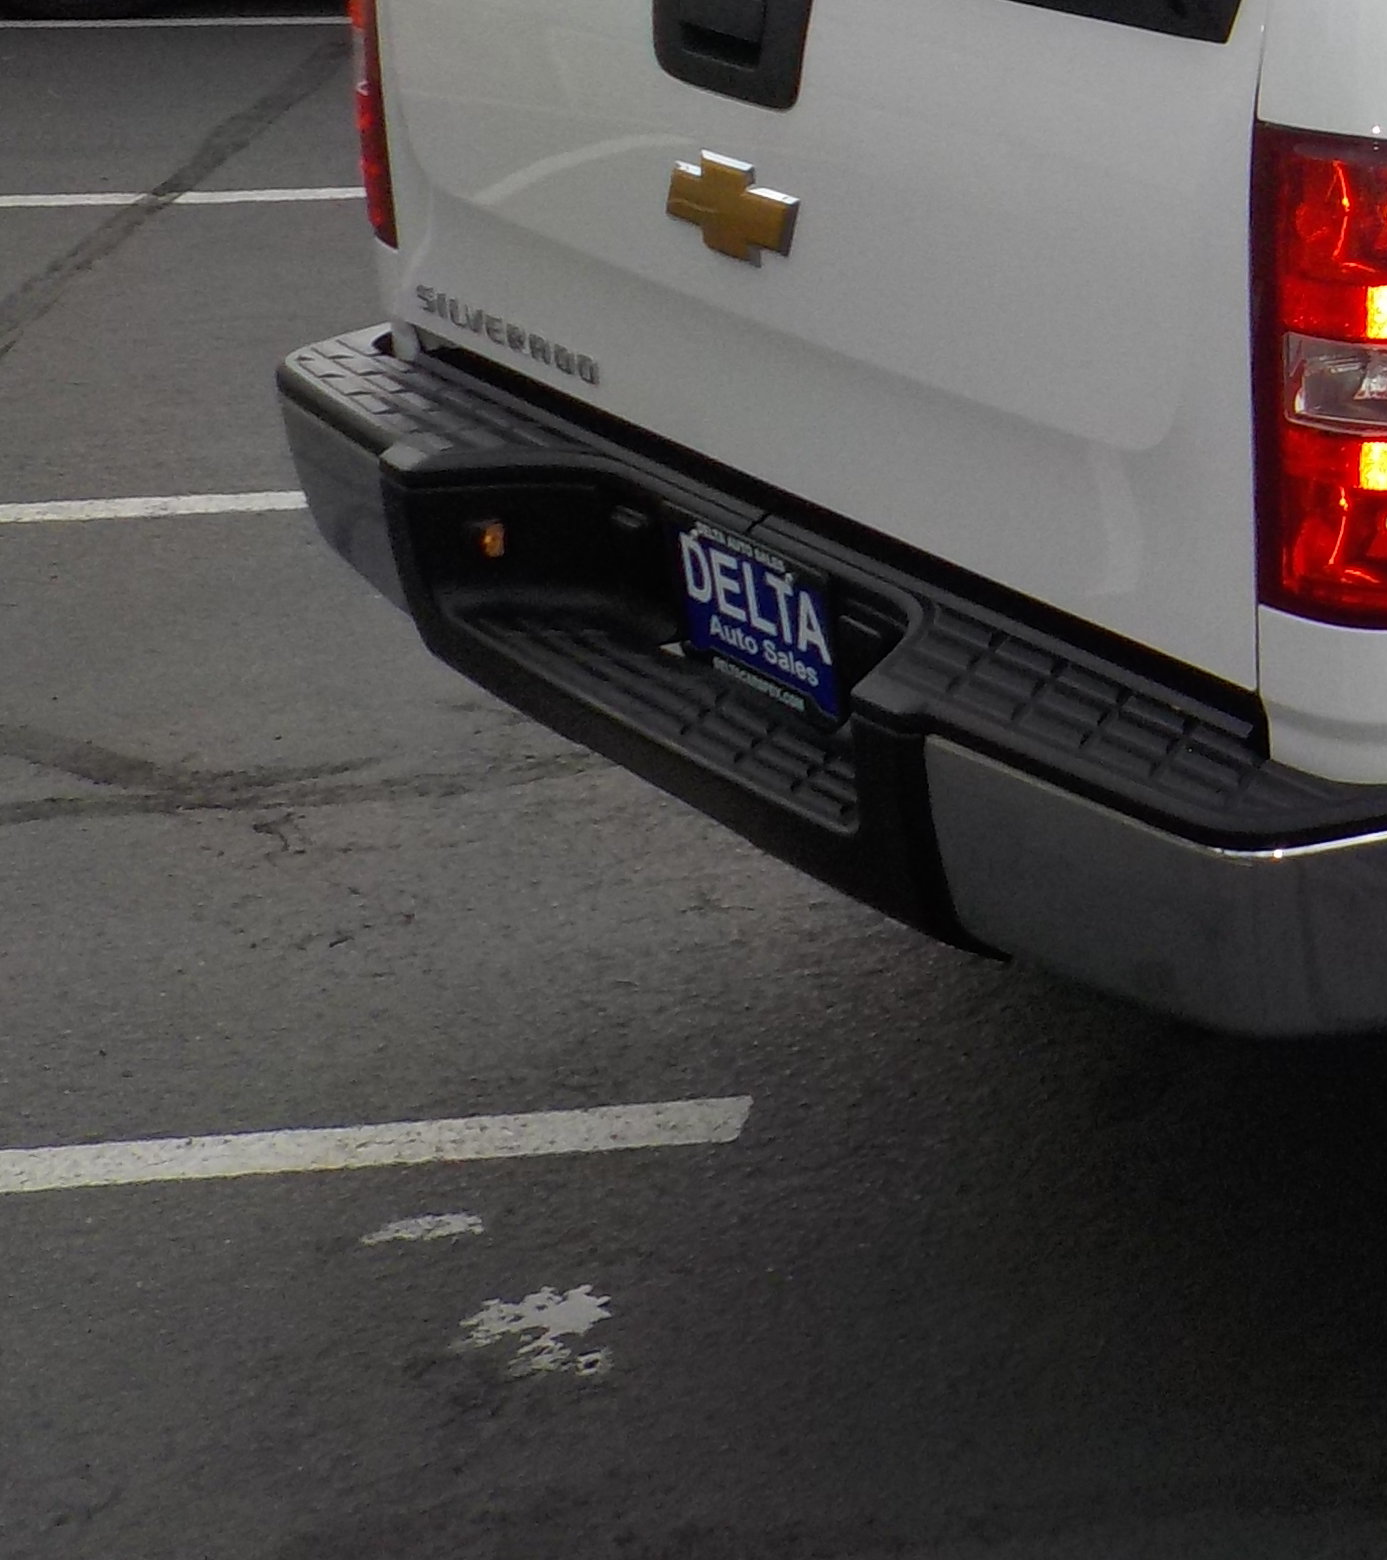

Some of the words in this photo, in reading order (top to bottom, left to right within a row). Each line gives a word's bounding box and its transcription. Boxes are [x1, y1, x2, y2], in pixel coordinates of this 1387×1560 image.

[416, 284, 600, 385] SILVERADO
[679, 531, 833, 666] DELTA
[709, 614, 760, 656] Auto
[762, 640, 820, 688] Sales
